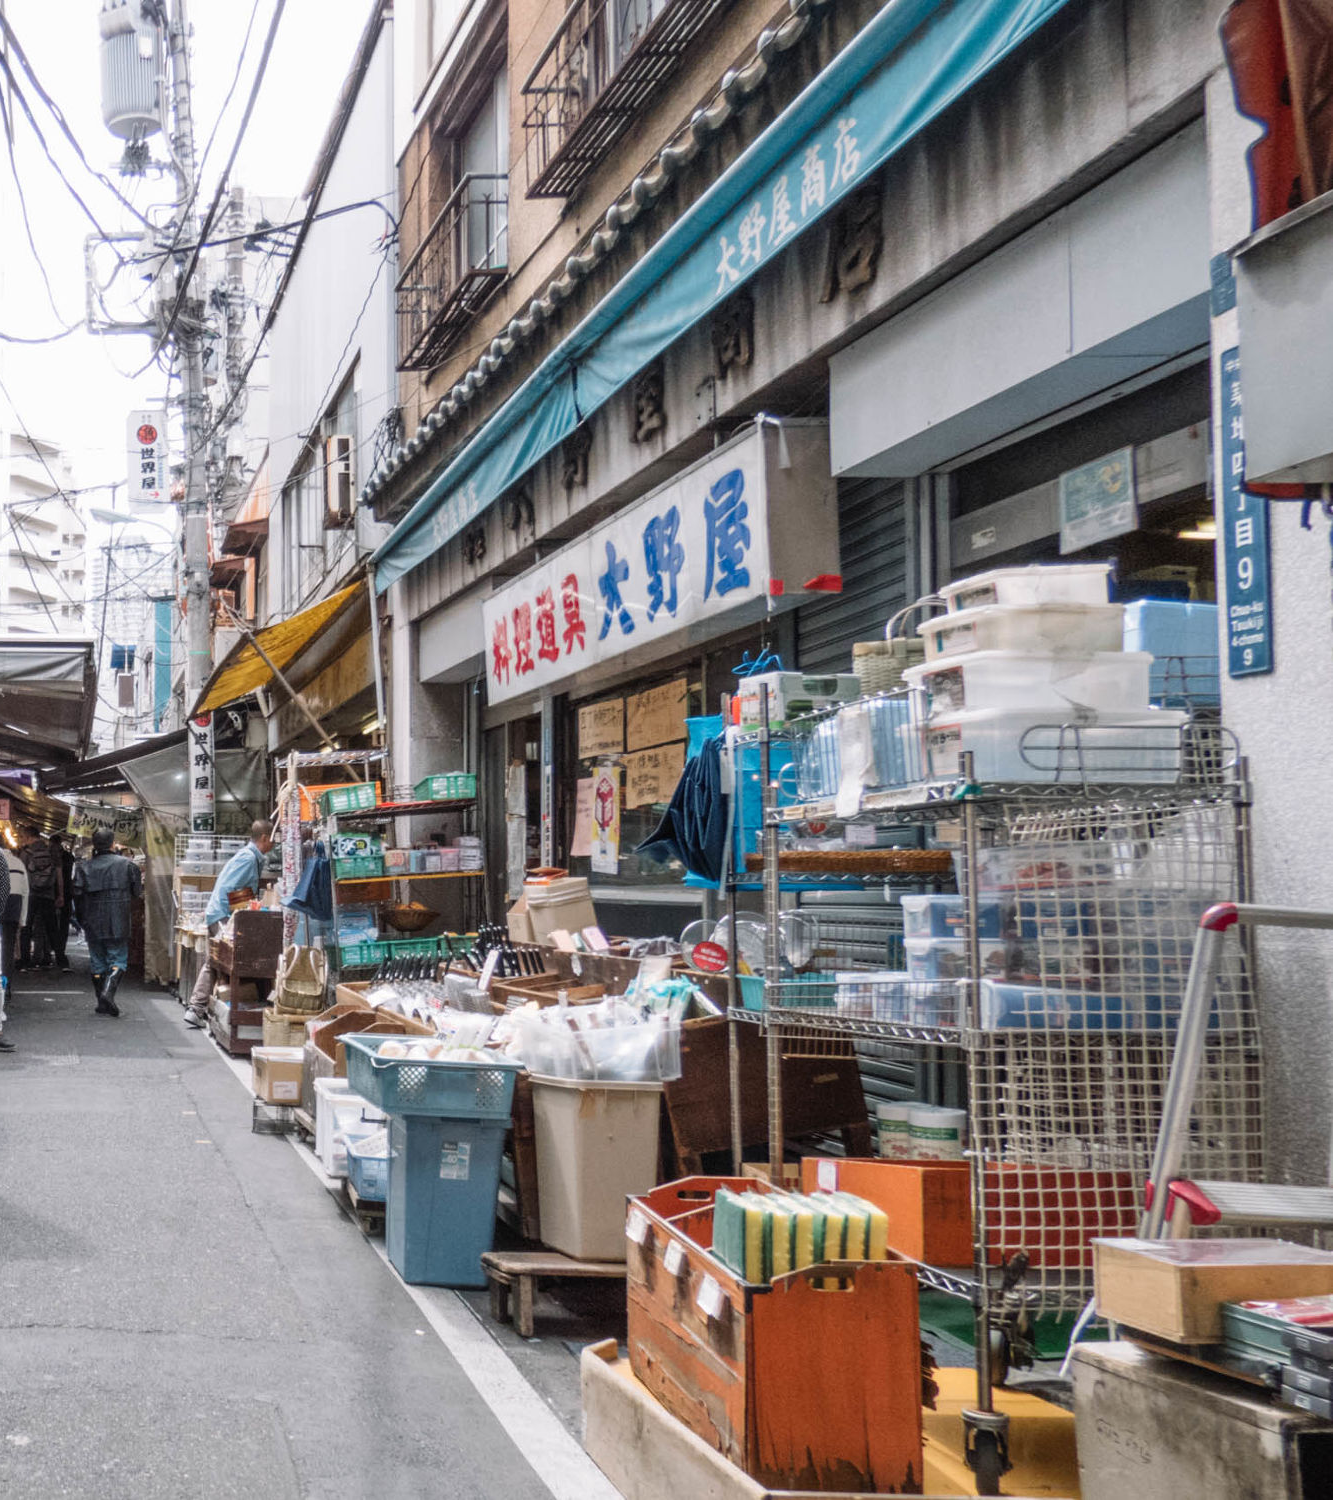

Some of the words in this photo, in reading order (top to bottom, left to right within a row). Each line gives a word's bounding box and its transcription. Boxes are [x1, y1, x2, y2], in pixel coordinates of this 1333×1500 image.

[715, 118, 861, 296] 大野屋商店
[141, 447, 155, 489] 世界屋
[493, 573, 586, 686] 料理道具
[598, 468, 751, 641] 大野屋
[1230, 601, 1264, 618] Chuo-ku
[1231, 615, 1265, 633] Tsukiji
[1231, 632, 1265, 647] 4-chome
[1243, 648, 1254, 666] 9
